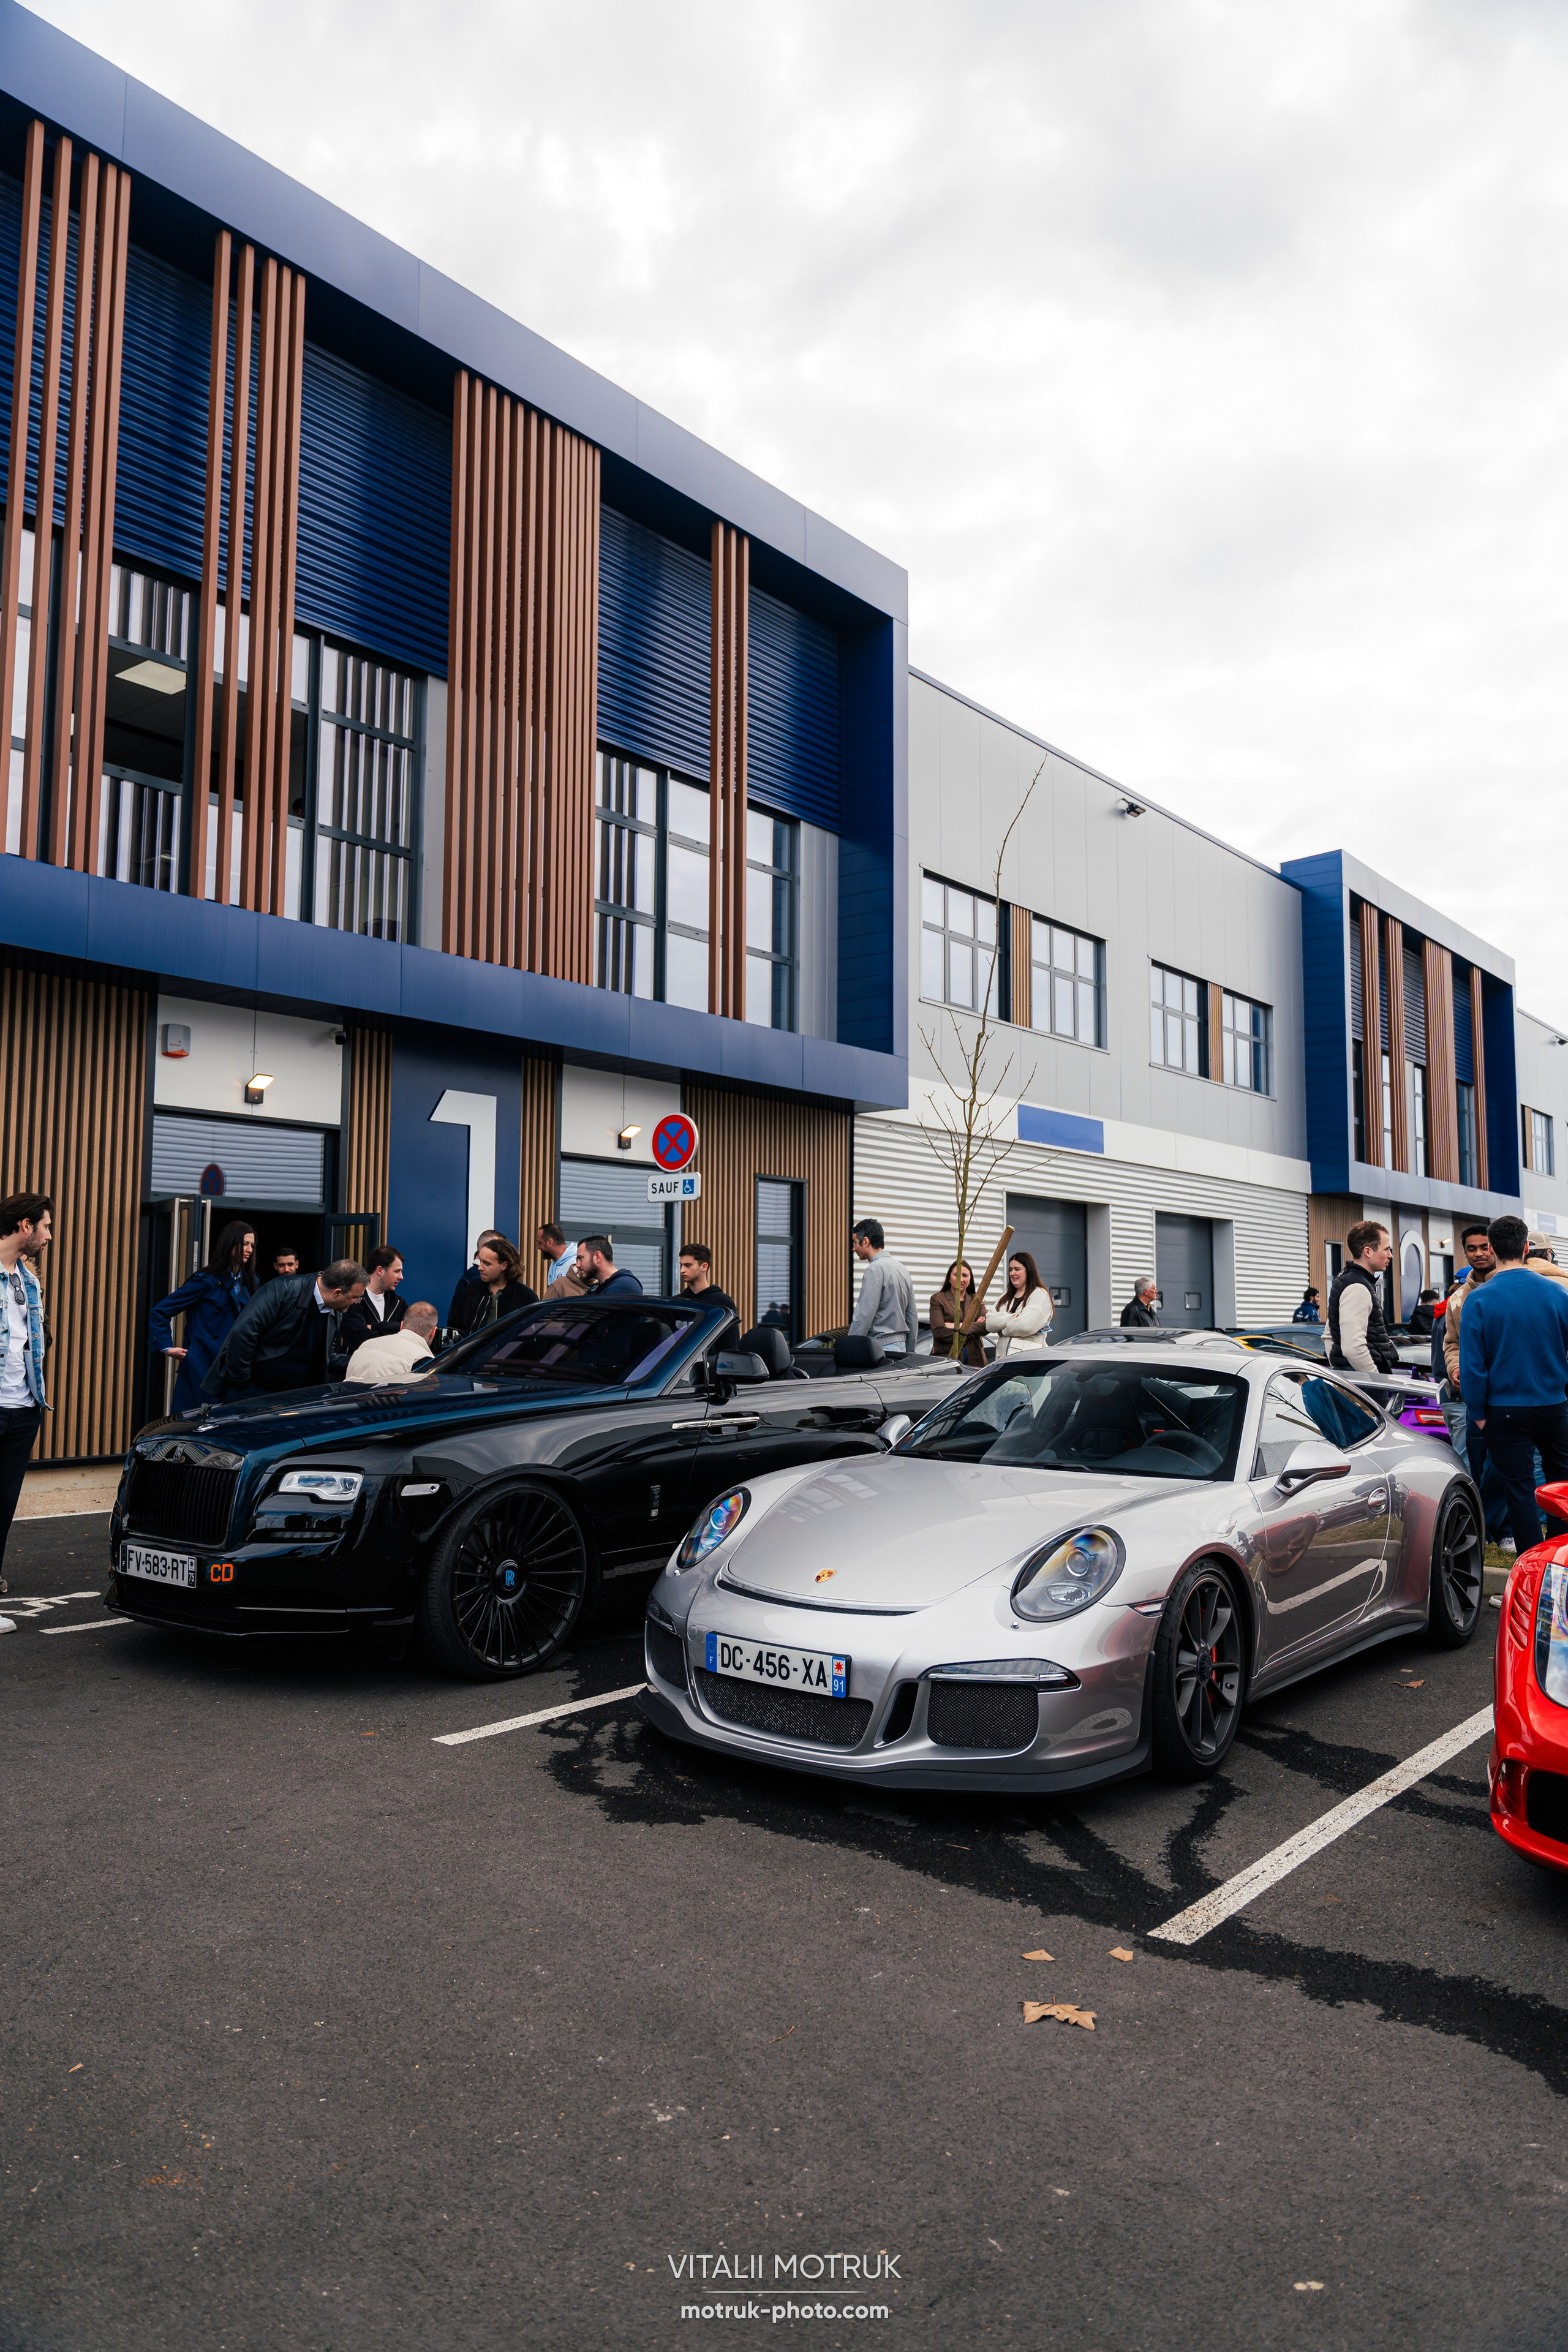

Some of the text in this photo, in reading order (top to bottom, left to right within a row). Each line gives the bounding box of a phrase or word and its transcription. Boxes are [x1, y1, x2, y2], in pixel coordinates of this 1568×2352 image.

[430, 1089, 497, 1270] 1
[651, 1182, 679, 1194] SAUF
[127, 1549, 187, 1581] FV-583-RT
[189, 1572, 195, 1582] 75
[211, 1563, 233, 1582] CD
[720, 1642, 828, 1688] DC-456-XA
[834, 1679, 843, 1692] 91
